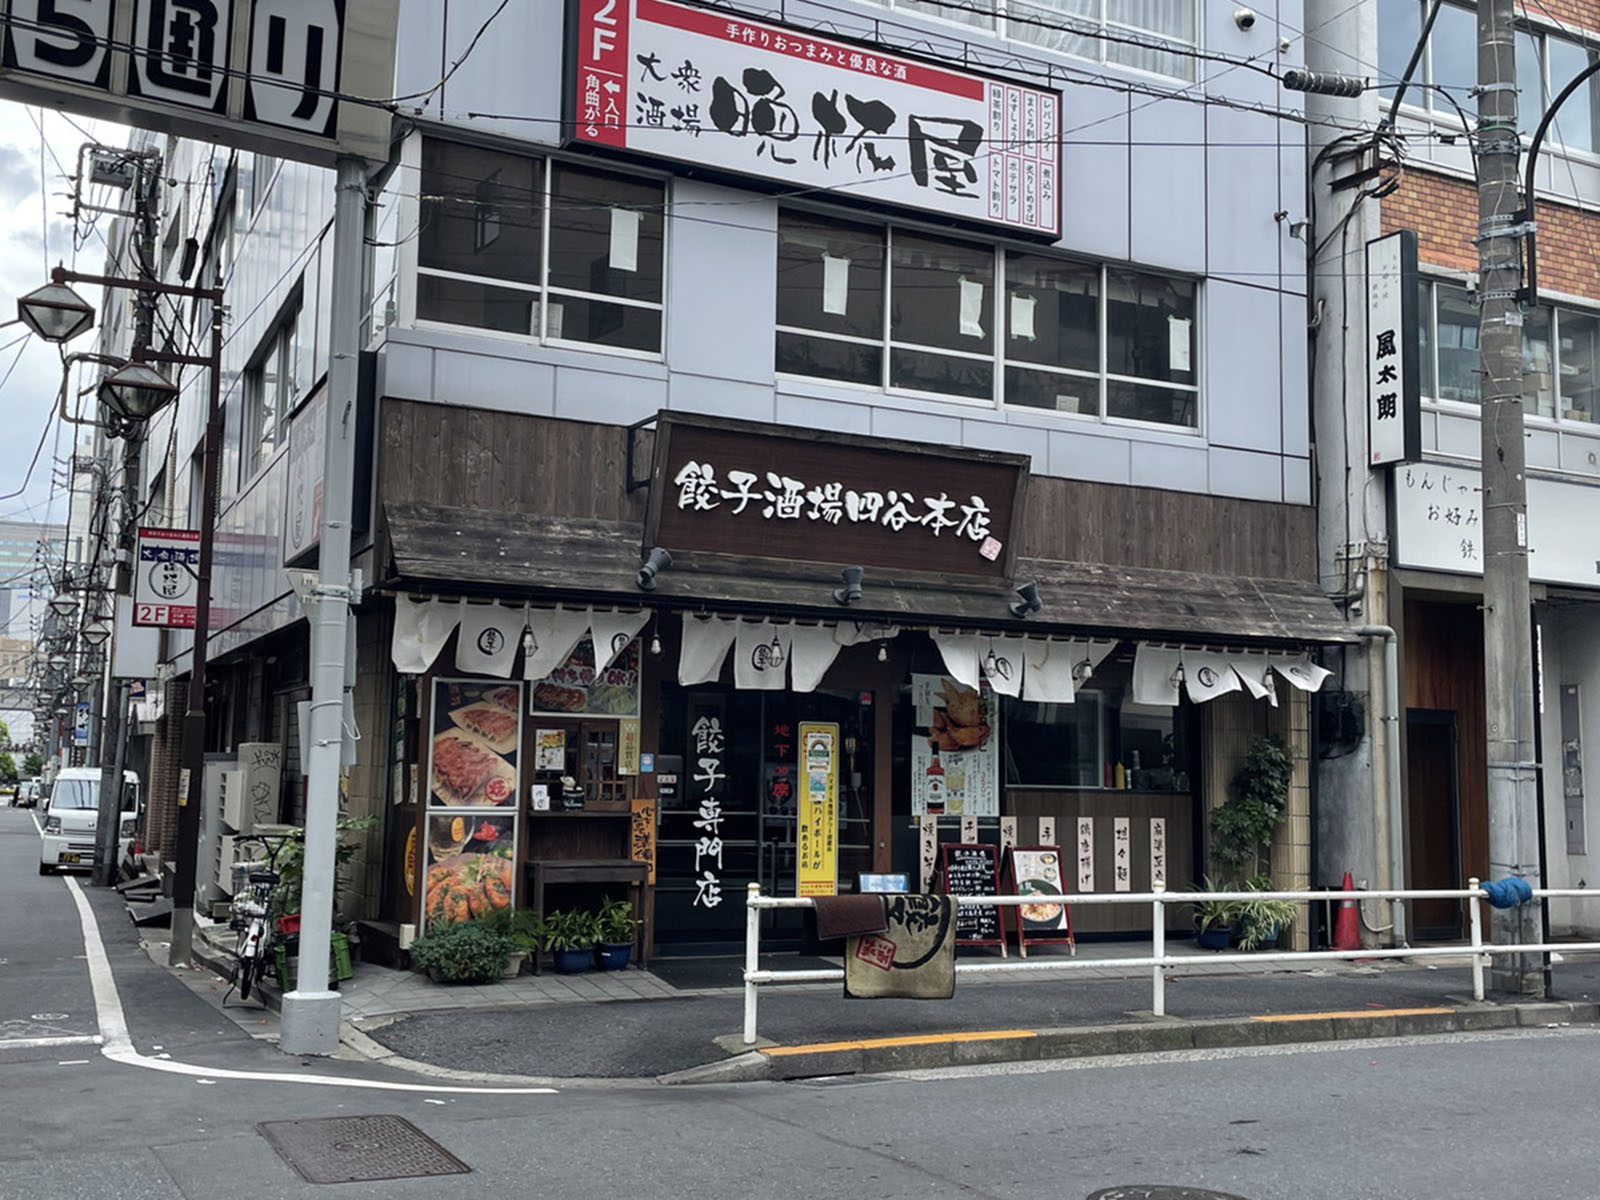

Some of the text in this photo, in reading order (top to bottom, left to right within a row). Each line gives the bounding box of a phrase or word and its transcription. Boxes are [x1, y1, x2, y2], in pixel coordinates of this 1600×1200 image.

[593, 0, 618, 61] 2F
[725, 23, 907, 80] 手作りおつまみと優良な酒
[636, 52, 702, 93] 大衆
[584, 74, 600, 137] 角曲がる
[604, 98, 620, 130] 入口
[635, 92, 702, 137] 酒場
[709, 67, 985, 199] 晩杯屋
[673, 460, 992, 541] 餃子酒場四谷本店
[1405, 469, 1469, 495] もんじゃ
[1427, 503, 1479, 527] お好み
[140, 606, 166, 622] 2F
[691, 715, 726, 908] 餃子専門店
[813, 800, 822, 870] ハイボールが
